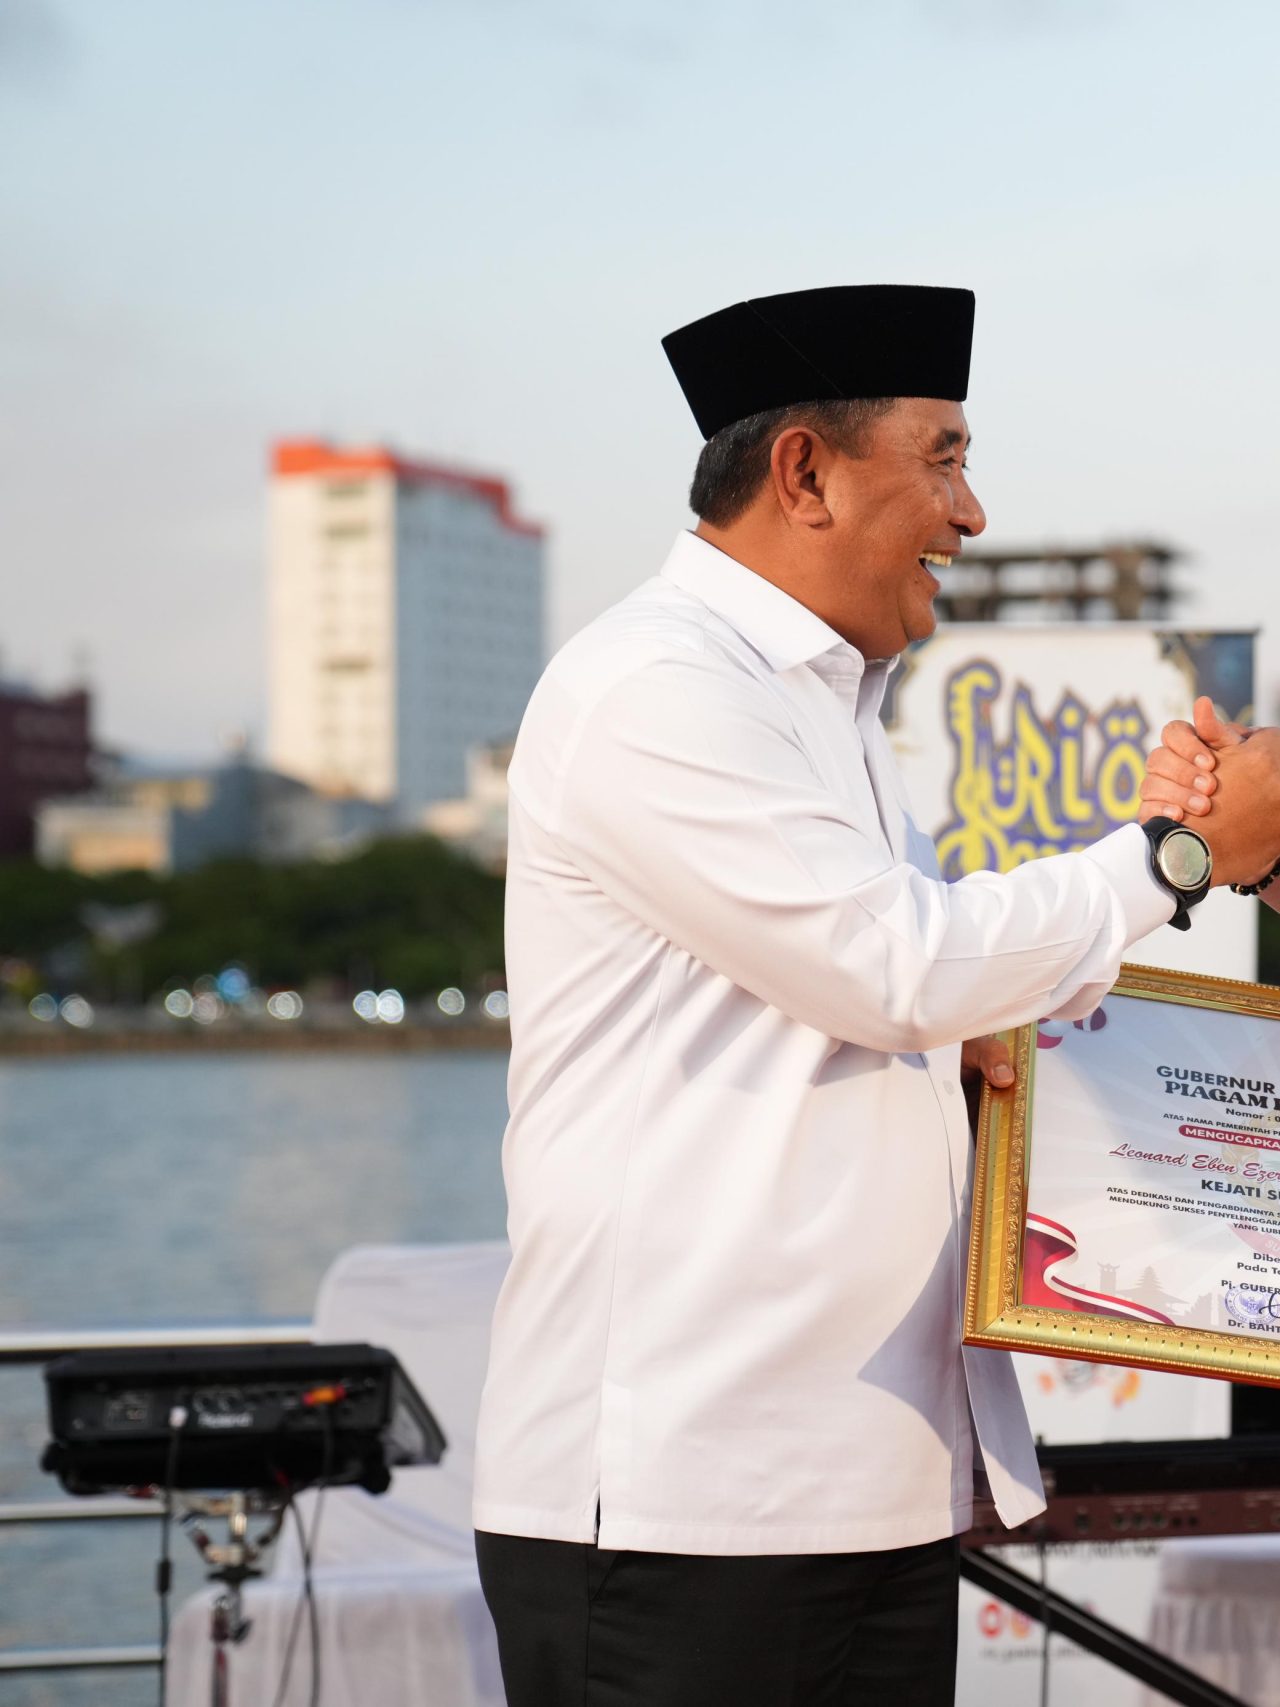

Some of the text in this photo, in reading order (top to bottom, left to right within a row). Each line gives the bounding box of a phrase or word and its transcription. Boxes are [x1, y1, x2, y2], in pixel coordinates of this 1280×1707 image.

[1156, 1065, 1274, 1094] GUBERNUR
[1165, 1080, 1267, 1108] PIAGAM
[1163, 1112, 1184, 1121] ATAS
[1187, 1116, 1212, 1125] NAMA
[1216, 1120, 1269, 1134] PEMERINTAH
[1226, 1108, 1263, 1120] Nomor
[1110, 1140, 1186, 1166] Leonard
[1191, 1153, 1236, 1174] Eben
[1201, 1179, 1260, 1197] KEJATI
[1106, 1186, 1128, 1194] ATAS
[1131, 1189, 1171, 1201] DEDIKASI
[1175, 1196, 1193, 1204] DAN
[1197, 1199, 1274, 1216] PENGABDIANNYA
[1110, 1195, 1169, 1209] MENDUKUNG
[1172, 1204, 1205, 1215] SUKSES
[1233, 1222, 1258, 1231] YANG
[1237, 1262, 1267, 1273] Pada
[1228, 1319, 1244, 1328] Dr.
